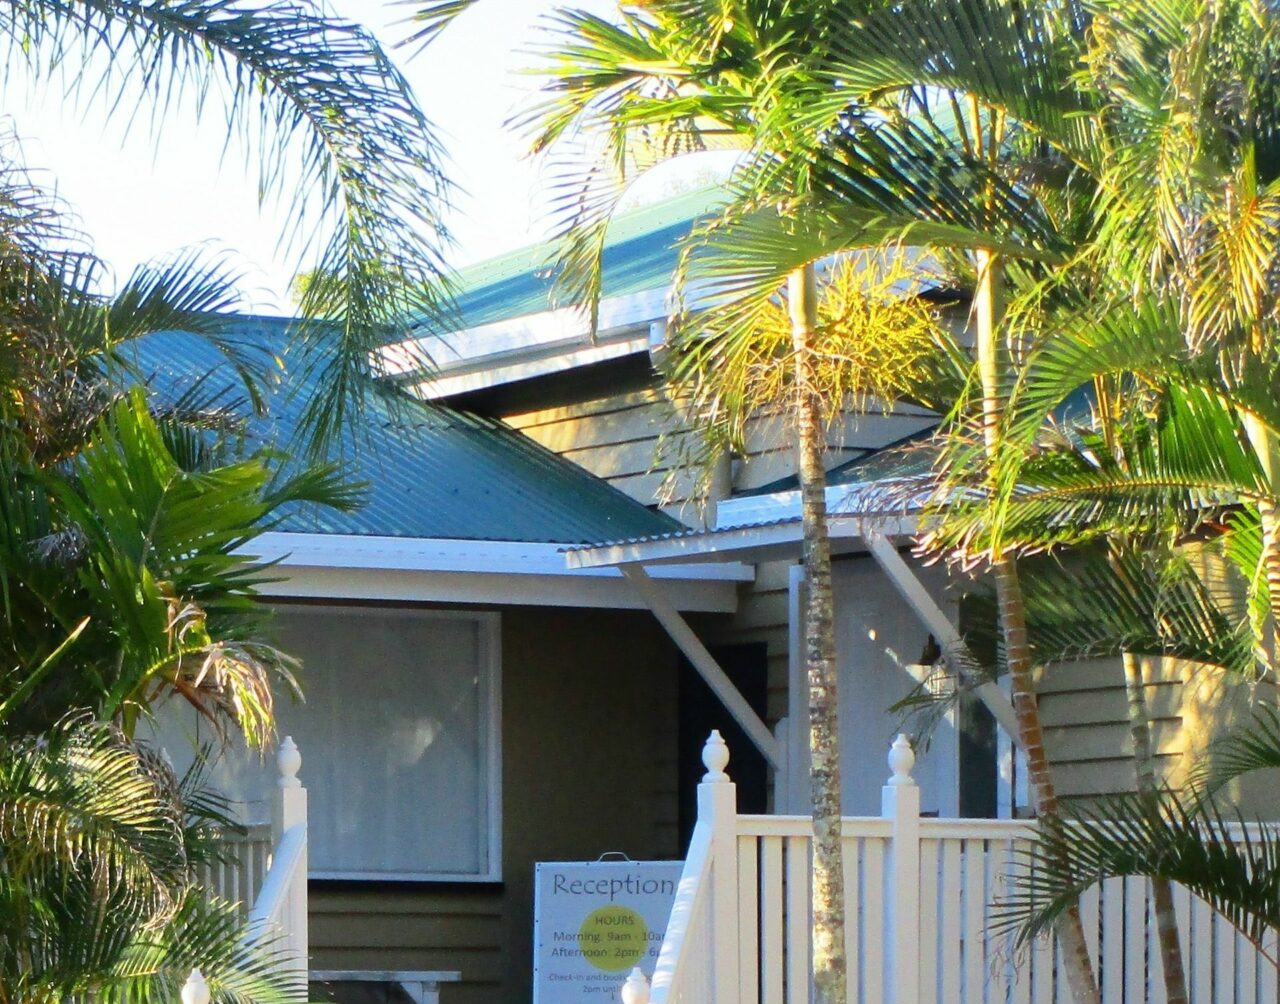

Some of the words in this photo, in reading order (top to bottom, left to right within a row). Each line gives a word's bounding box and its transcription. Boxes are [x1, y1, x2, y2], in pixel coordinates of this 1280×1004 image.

[553, 873, 675, 902] Reception
[595, 916, 634, 926] HOURS
[607, 931, 631, 941] 9am
[615, 947, 639, 958] 2pm
